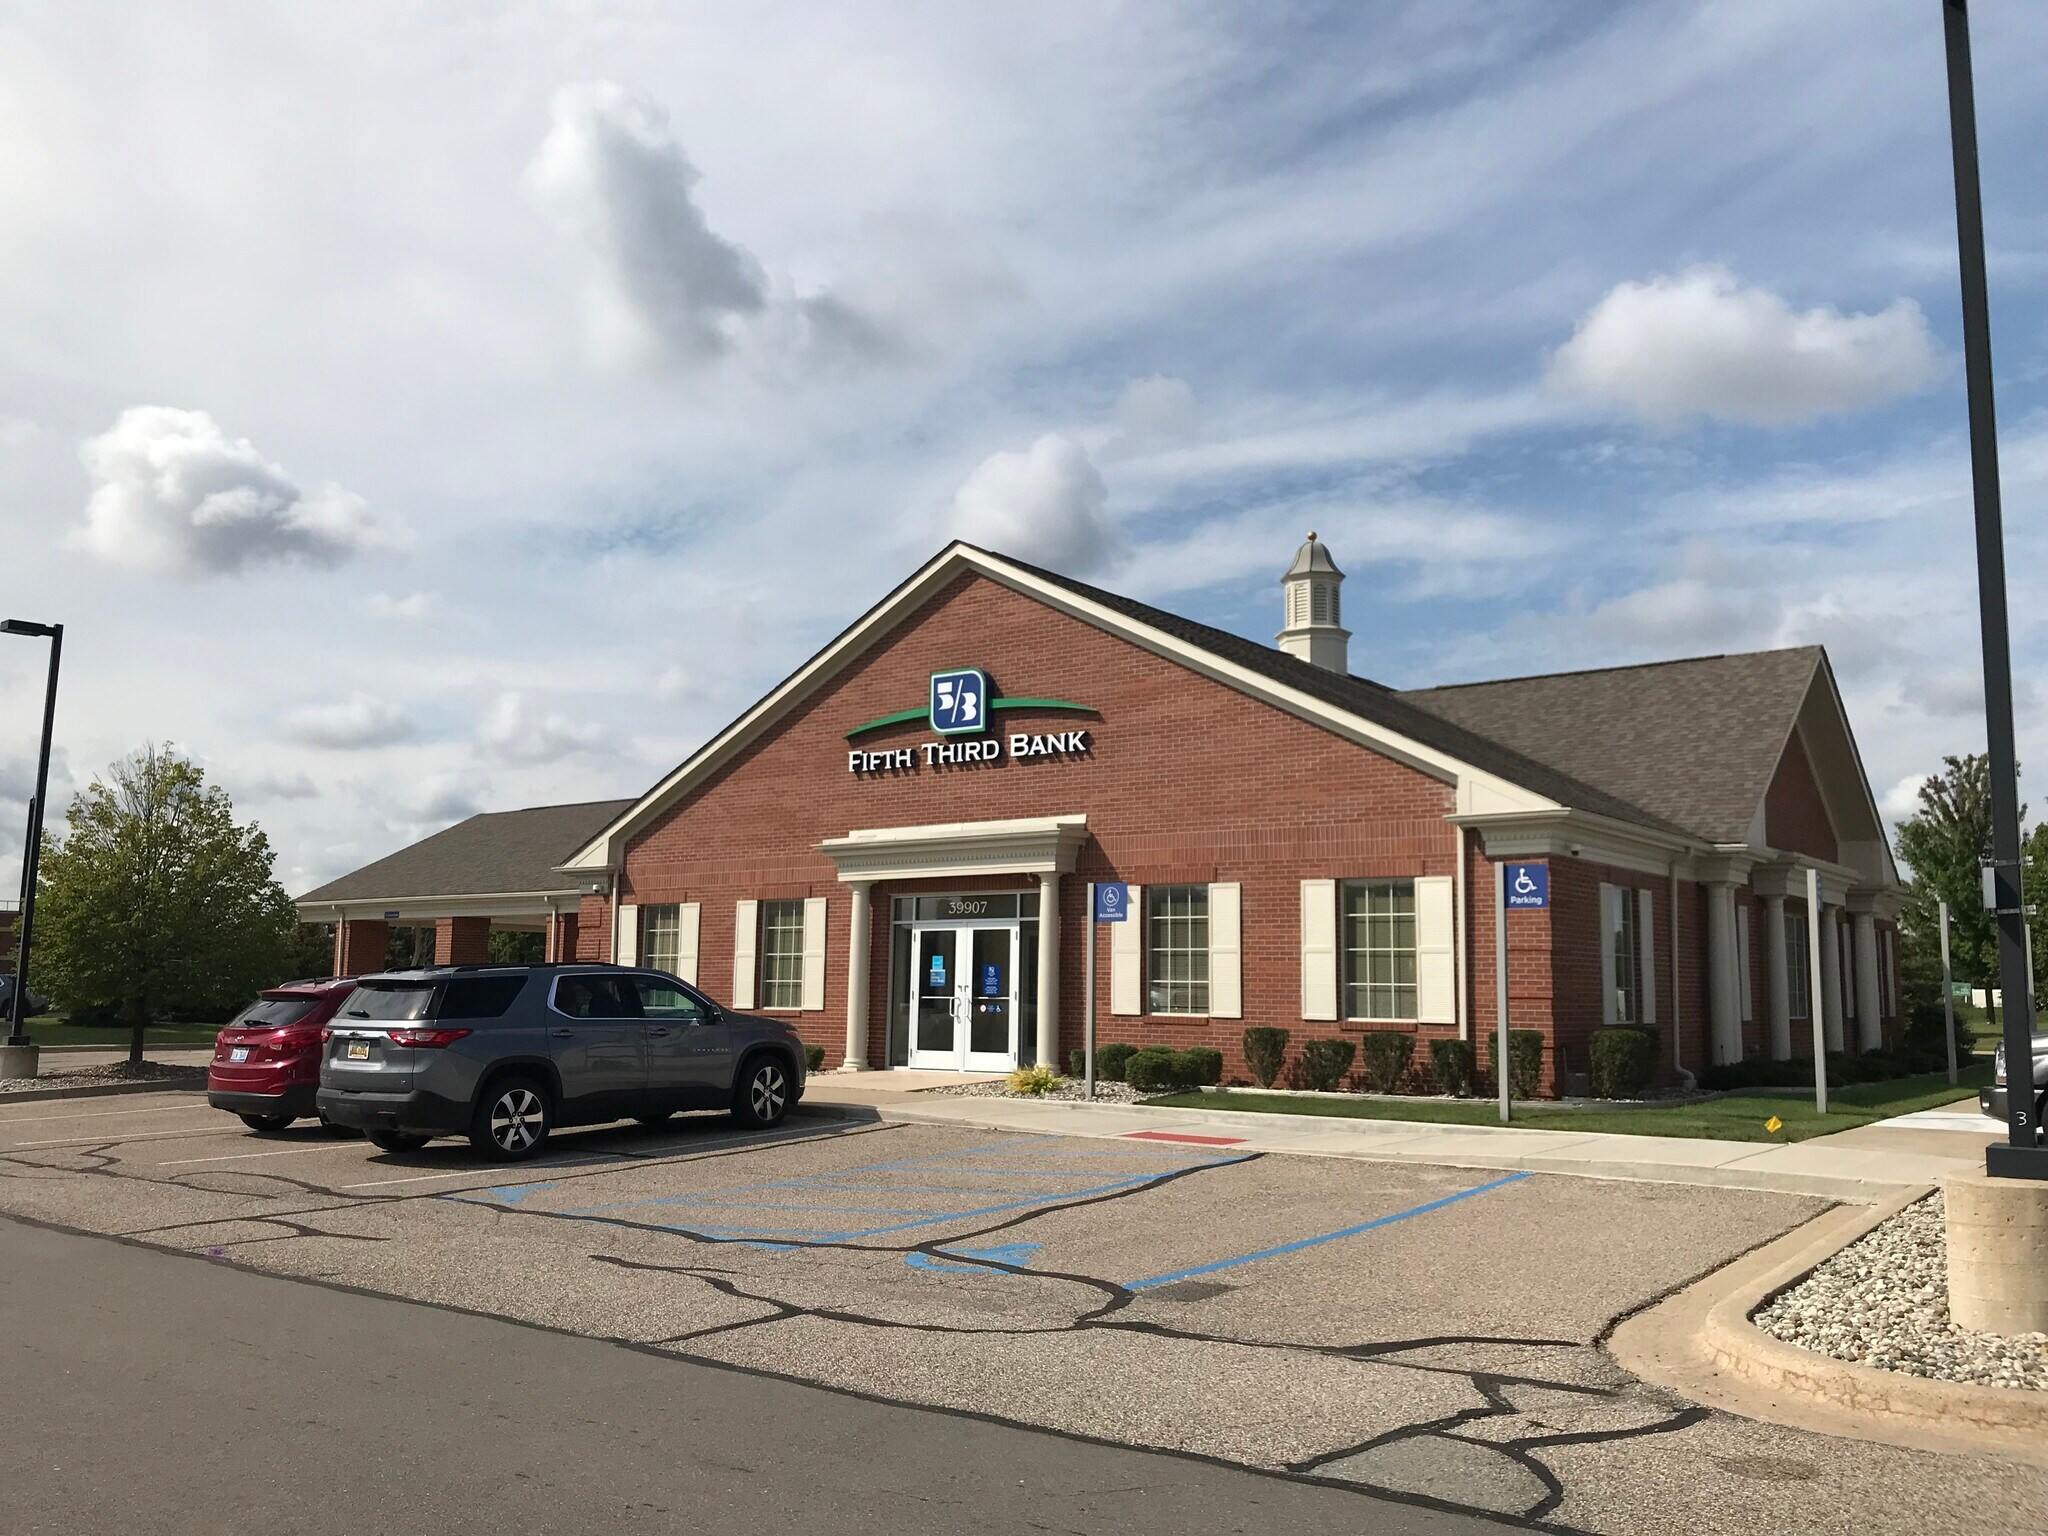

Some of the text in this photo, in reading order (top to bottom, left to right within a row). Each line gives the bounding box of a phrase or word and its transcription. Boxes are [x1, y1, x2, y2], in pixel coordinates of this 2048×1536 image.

[848, 731, 1086, 772] FIFTH THIRD BANK
[1510, 895, 1542, 905] Parking
[948, 901, 988, 914] 39907
[2016, 1111, 2027, 1126] 3
